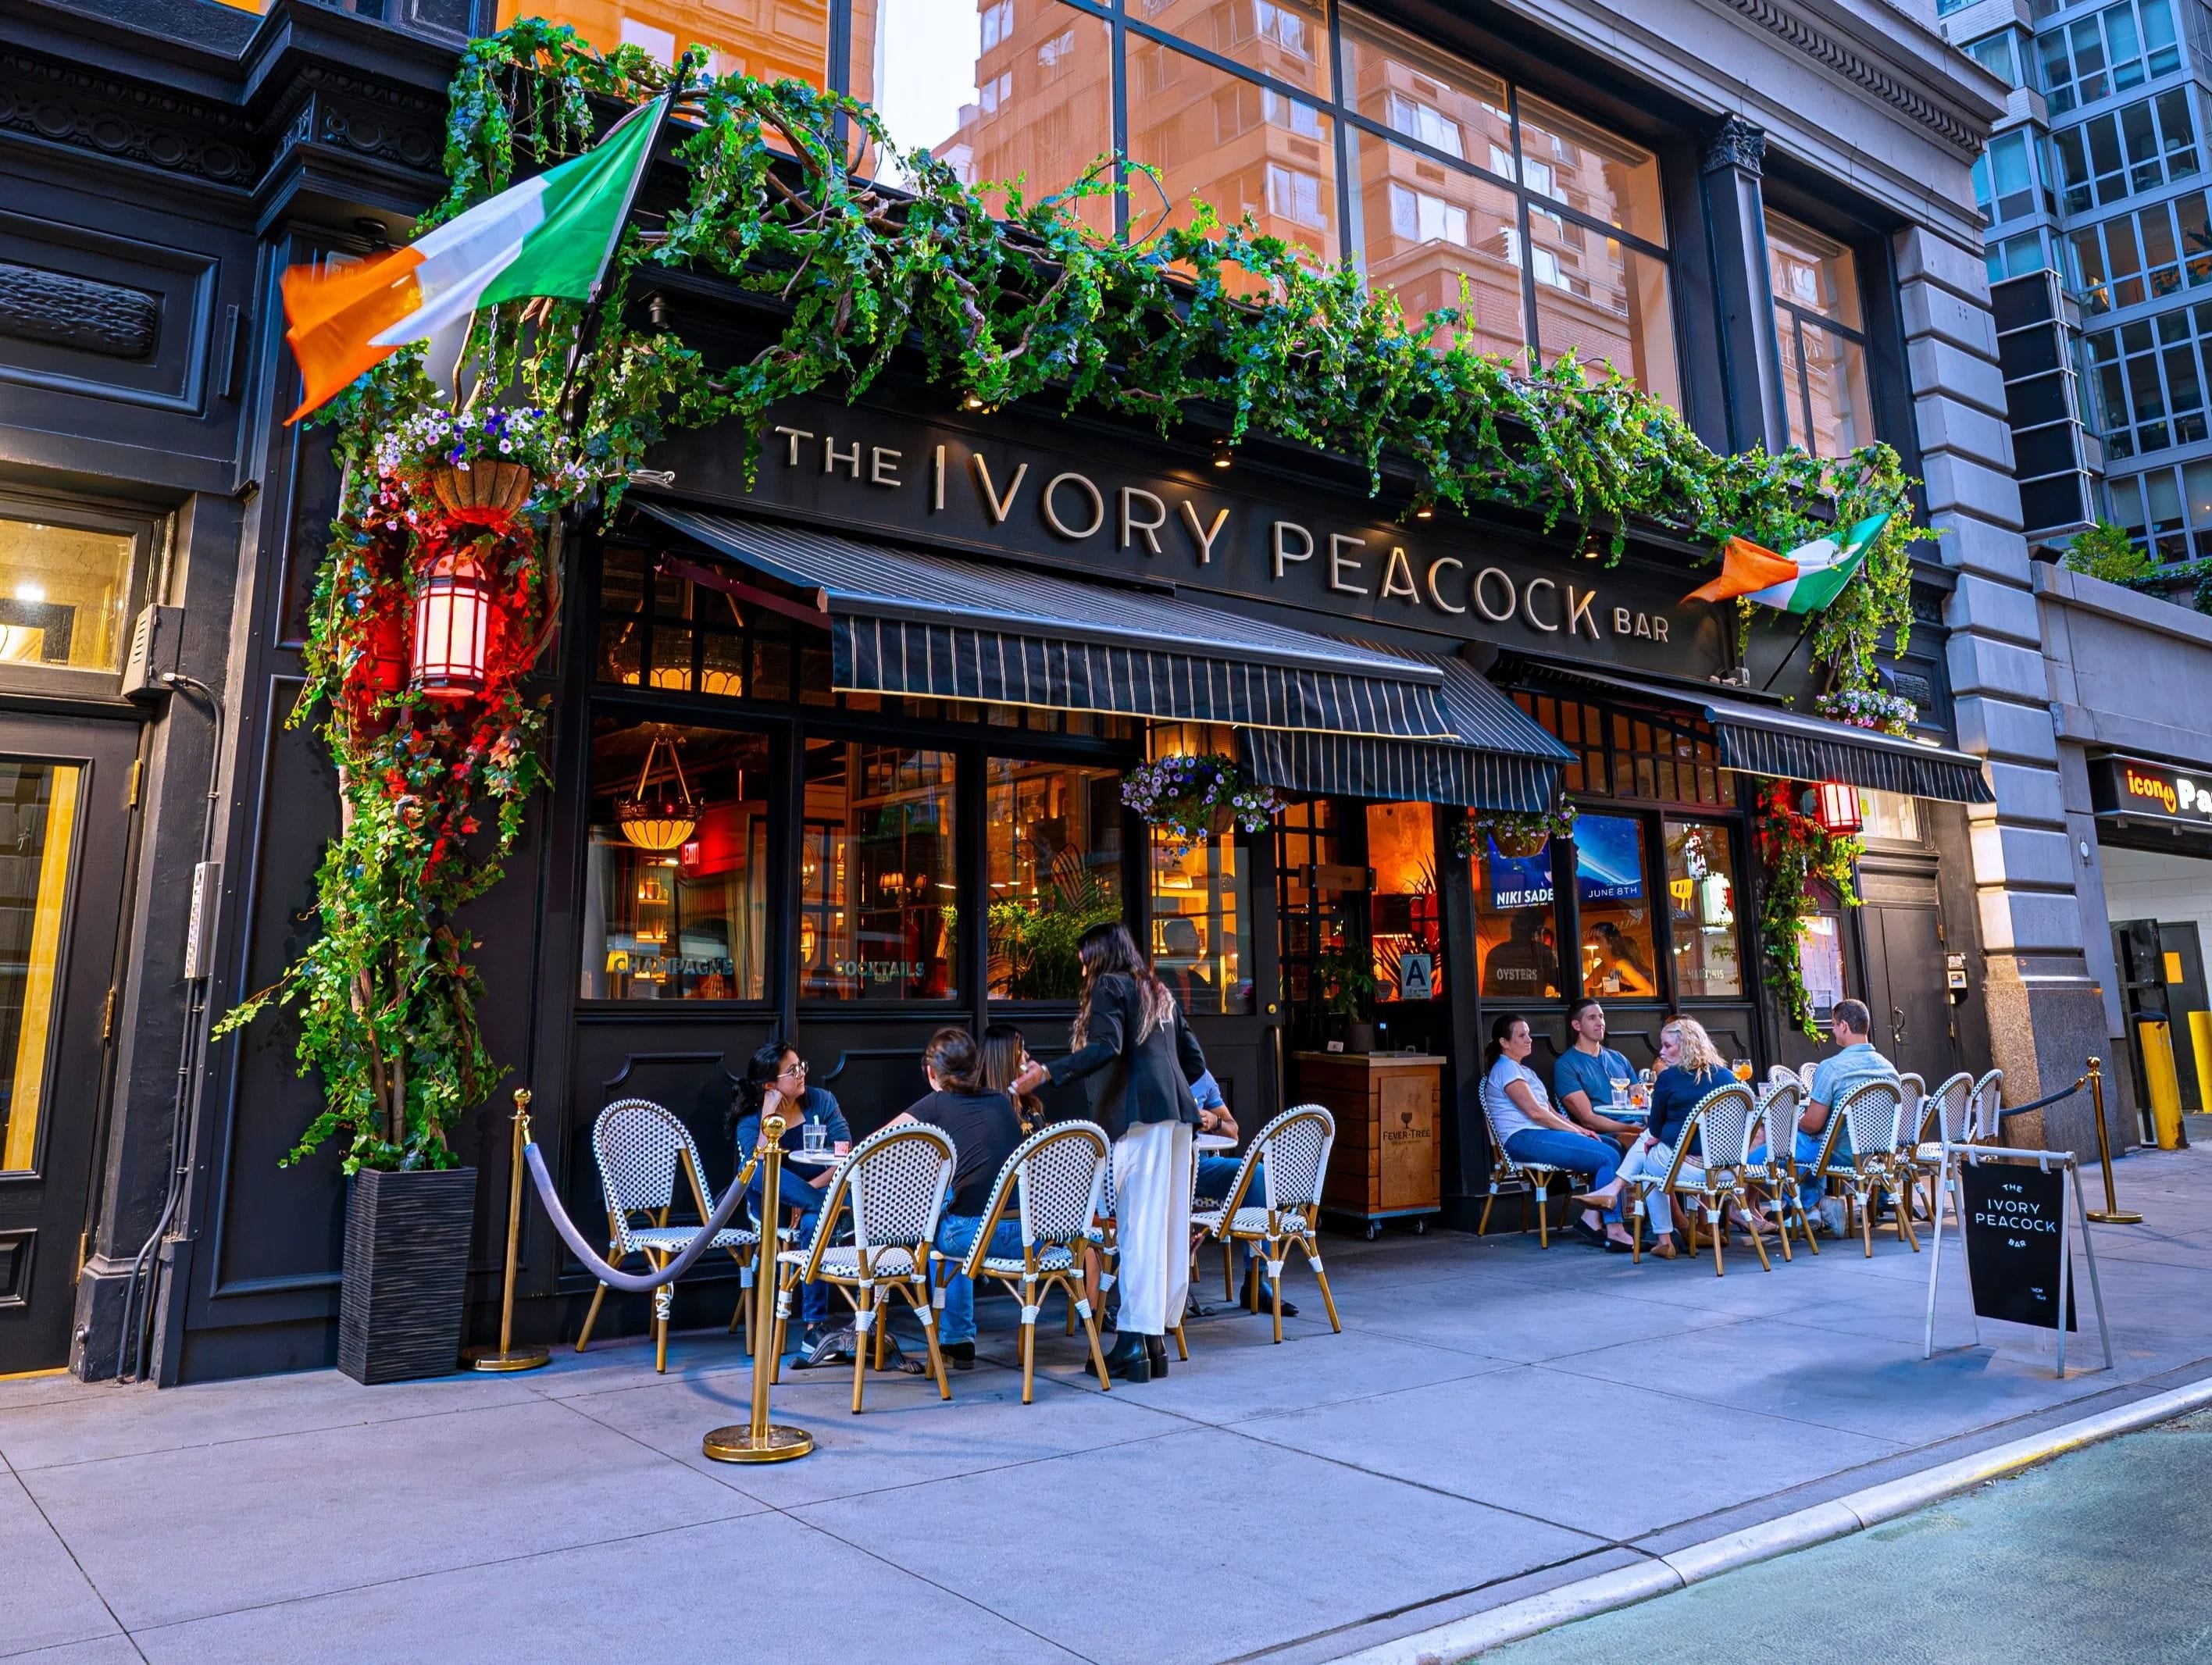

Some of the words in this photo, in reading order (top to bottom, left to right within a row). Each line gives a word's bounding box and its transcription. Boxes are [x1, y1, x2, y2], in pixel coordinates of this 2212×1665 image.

[774, 426, 902, 487] THE
[934, 444, 1230, 564] IVORY
[1273, 520, 1600, 640] PEACOCK
[1613, 607, 1669, 644] BAR
[2176, 778, 2212, 813] Pa
[1497, 890, 1522, 905] NIKI
[1524, 888, 1554, 903] SADE
[1588, 888, 1614, 898] JUNE
[1617, 886, 1637, 896] 8TH
[614, 955, 733, 975] CHAMPAGNE
[834, 961, 925, 977] COCKTAILS
[1406, 959, 1426, 986] A
[1497, 968, 1537, 981] OYSTERS
[2002, 1183, 2023, 1193] THE
[1987, 1198, 2040, 1214] IVORY
[1975, 1212, 2057, 1233] PEACOCK
[2008, 1238, 2027, 1248] BAR
